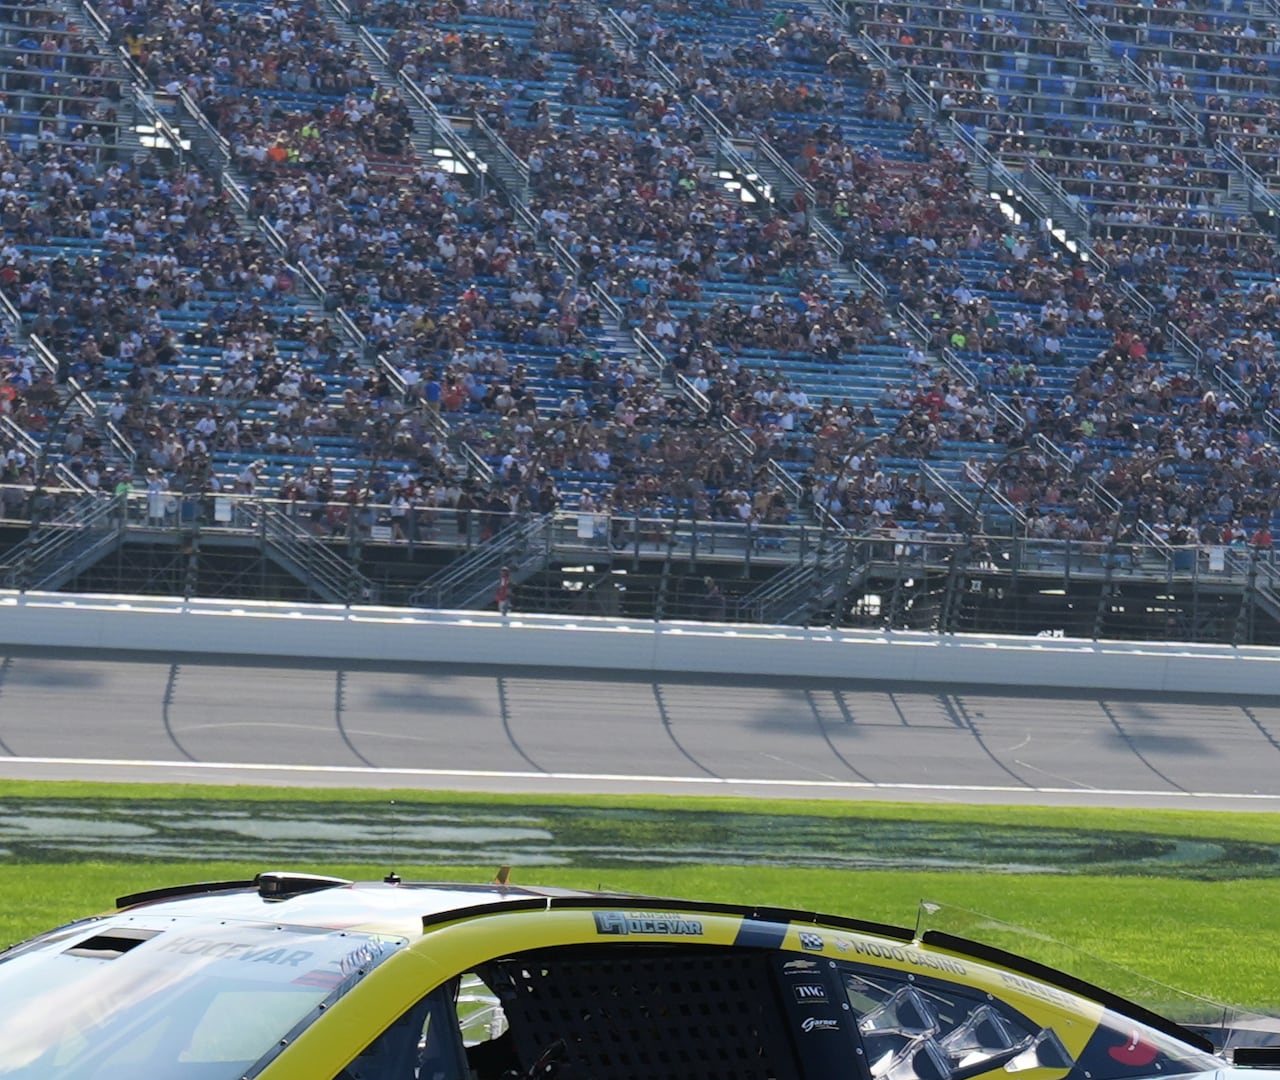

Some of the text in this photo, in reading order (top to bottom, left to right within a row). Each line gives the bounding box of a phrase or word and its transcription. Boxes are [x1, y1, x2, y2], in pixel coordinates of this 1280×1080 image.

[160, 937, 314, 967] HOCEVAR
[852, 940, 967, 976] MODO CASINO
